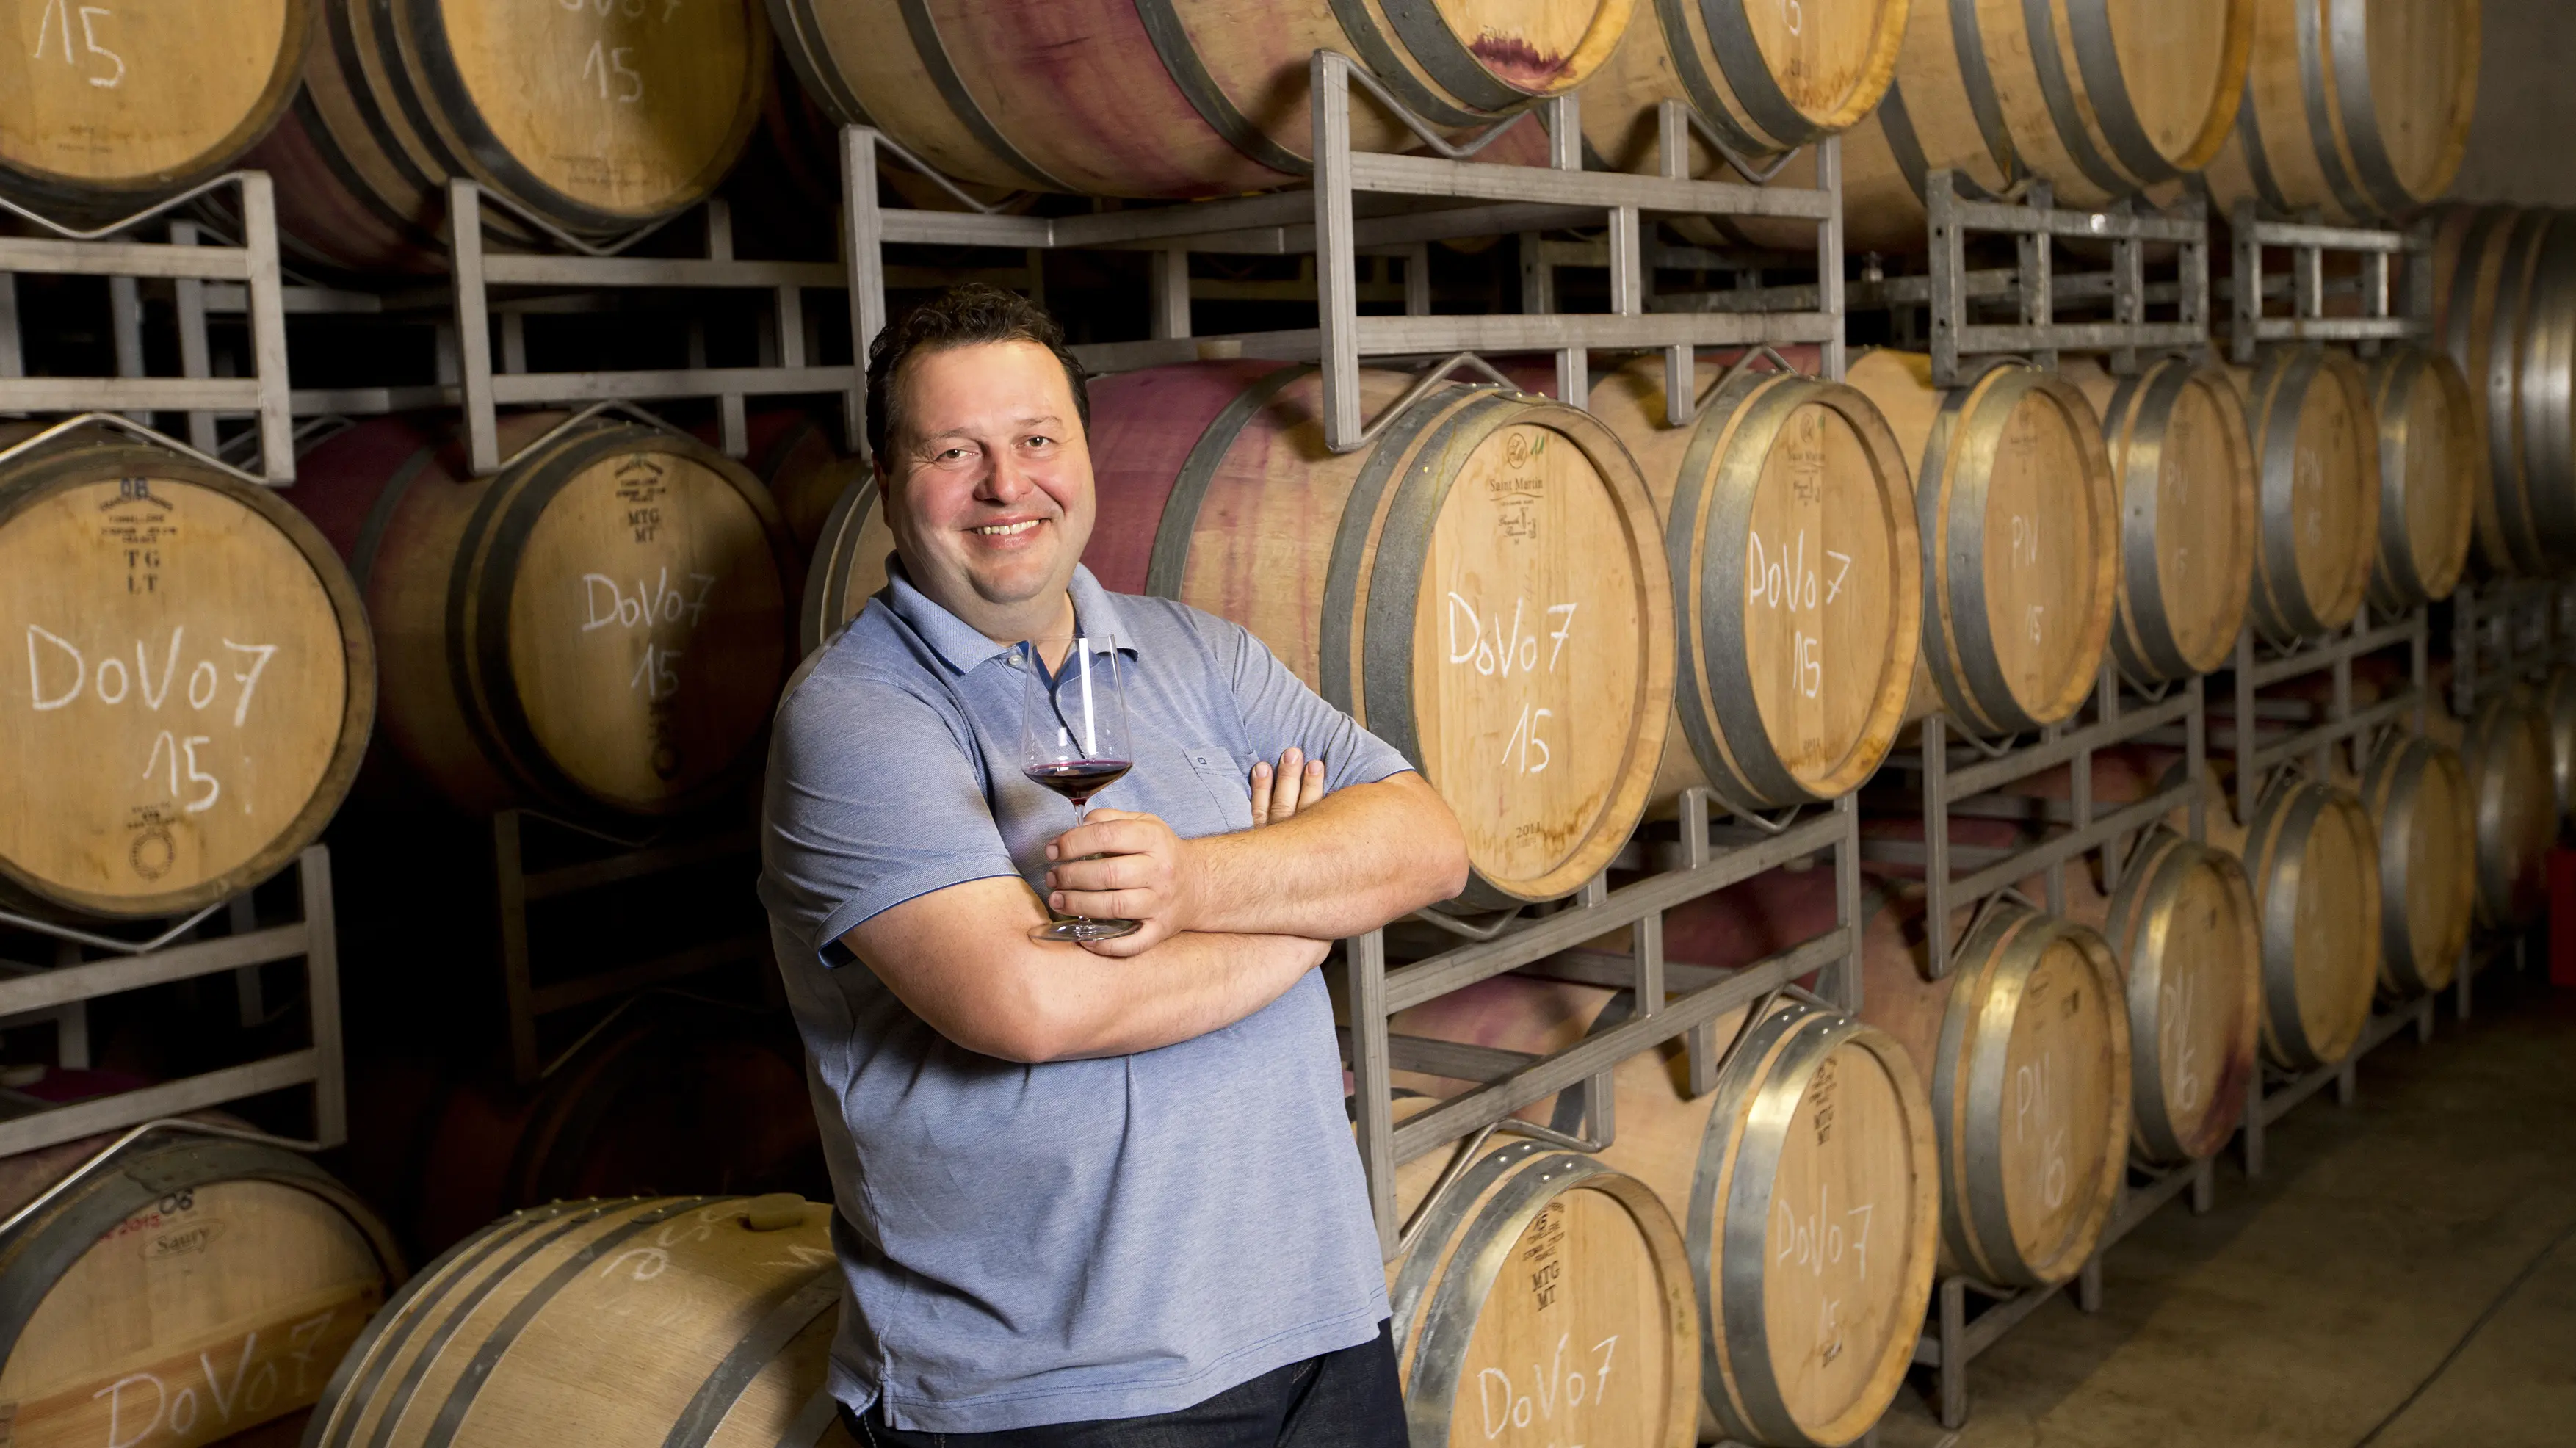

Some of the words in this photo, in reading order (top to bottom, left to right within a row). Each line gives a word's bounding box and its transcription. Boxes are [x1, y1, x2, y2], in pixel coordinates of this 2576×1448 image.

[33, 0, 126, 88] 15
[582, 40, 643, 103] 15
[628, 508, 659, 526] MTG
[1490, 478, 1512, 492] Saint
[1515, 477, 1543, 491] Martin
[635, 526, 654, 544] MT
[581, 568, 715, 634] DoVo7
[26, 624, 278, 728] DoVo7
[632, 642, 683, 698] 15
[1792, 630, 1821, 698] 15
[142, 729, 221, 814] 15
[1502, 703, 1555, 775] 15
[1532, 1260, 1560, 1292] MTG
[1538, 1284, 1556, 1311] MT
[93, 1311, 333, 1448] DoVo7
[1477, 1331, 1619, 1441] DoVo7
